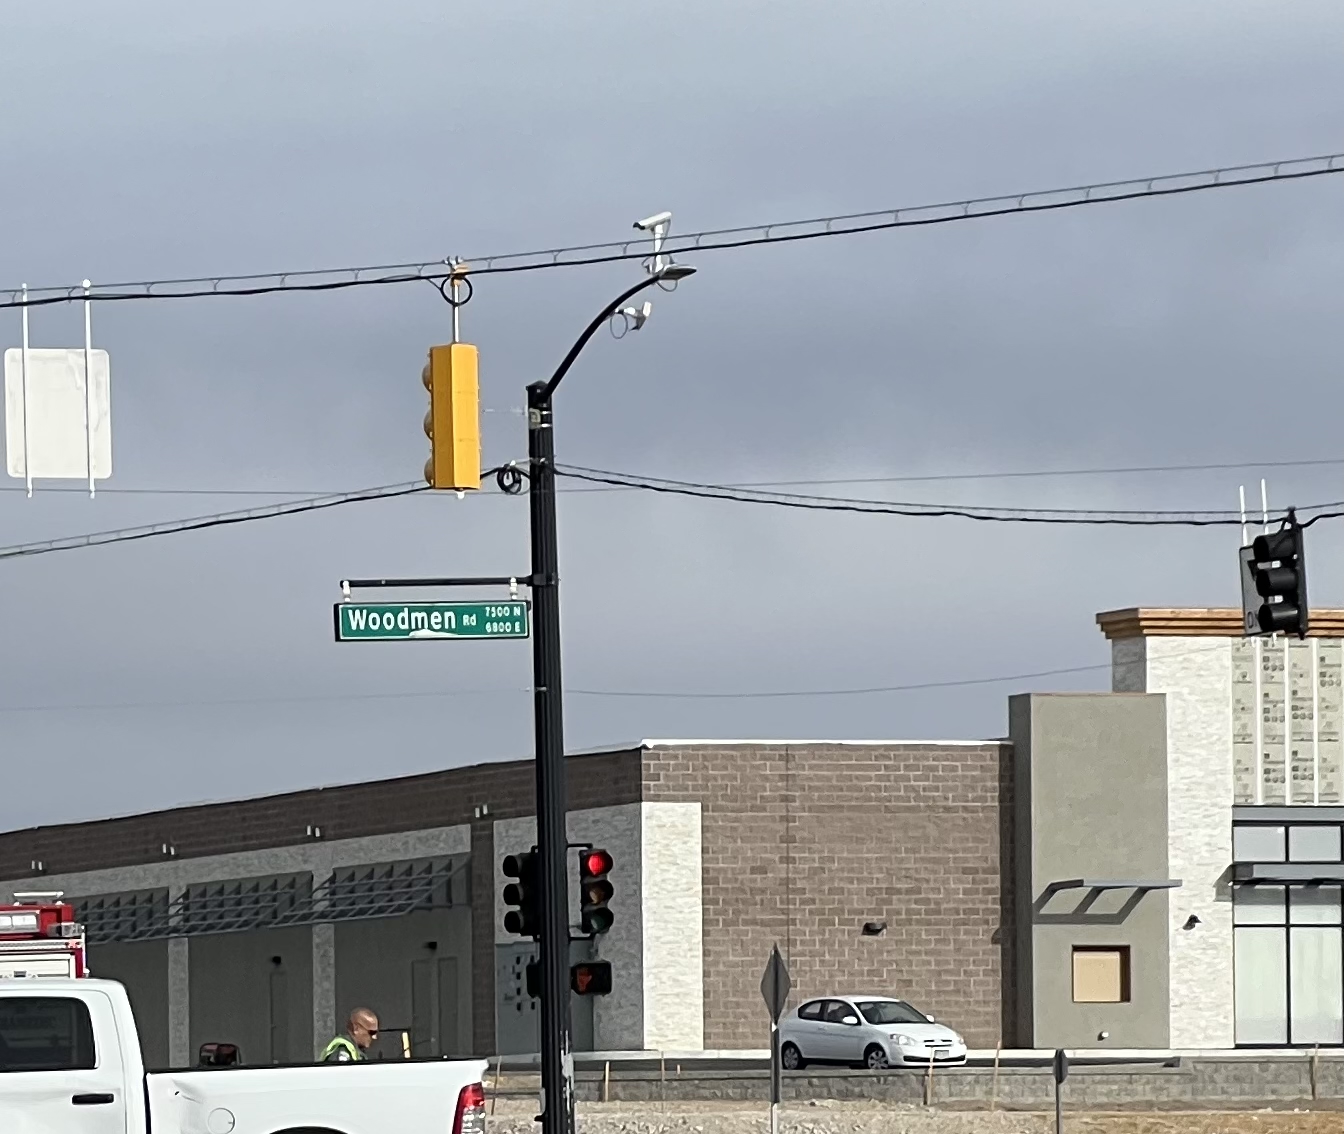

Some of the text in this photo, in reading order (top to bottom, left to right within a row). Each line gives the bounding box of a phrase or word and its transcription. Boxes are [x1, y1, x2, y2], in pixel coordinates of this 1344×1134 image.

[513, 606, 521, 617] N
[348, 607, 477, 630] Woodmen Rd
[514, 621, 521, 632] E
